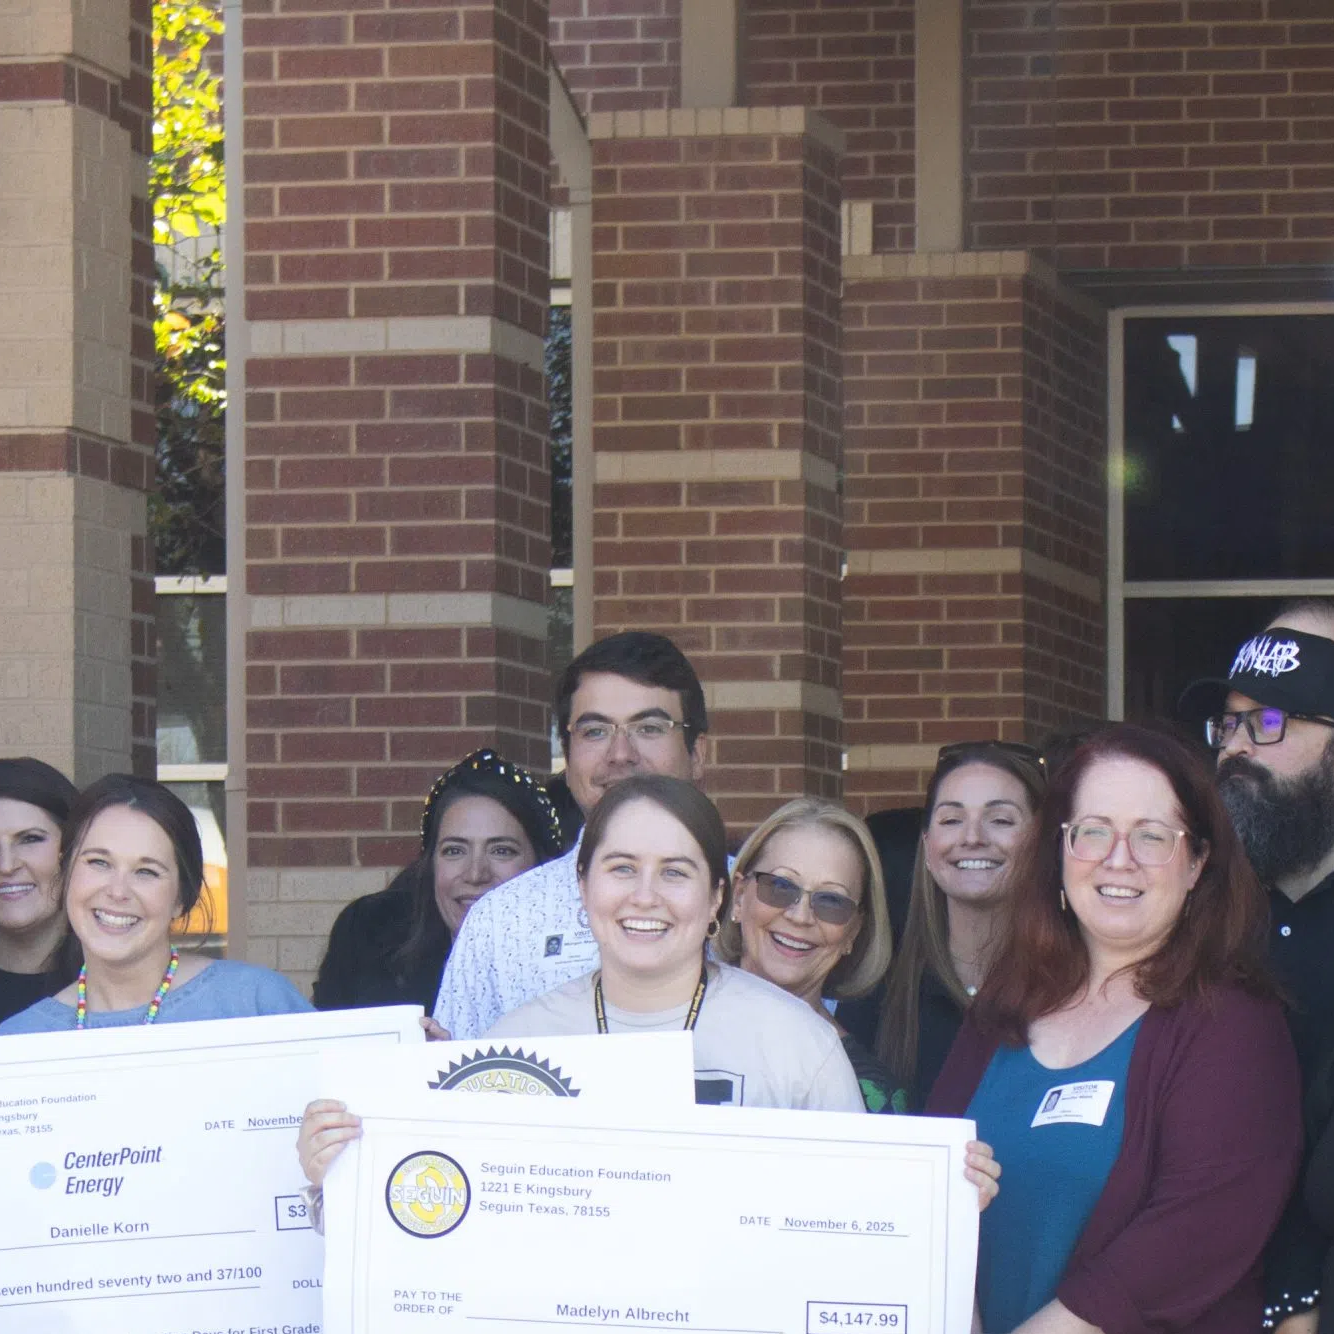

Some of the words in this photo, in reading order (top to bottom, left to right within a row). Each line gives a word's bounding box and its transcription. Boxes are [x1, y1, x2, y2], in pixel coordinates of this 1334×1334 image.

[41, 1093, 96, 1105] Foundation
[25, 1125, 53, 1134] 78155
[205, 1120, 235, 1130] DATE
[64, 1145, 162, 1169] CenterPoint
[481, 1163, 525, 1175] Seguin
[530, 1165, 593, 1178] Education
[598, 1168, 671, 1182] Foundation
[66, 1176, 124, 1197] Energy
[481, 1182, 508, 1192] 1221
[514, 1184, 522, 1193] E
[527, 1184, 591, 1199] Kingsbury
[390, 1185, 466, 1206] SEGUIN
[479, 1201, 523, 1214] Seguin
[529, 1203, 568, 1216] Texas,
[573, 1206, 610, 1217] 78155
[51, 1223, 109, 1239] Danielle
[114, 1221, 149, 1234] Korn
[740, 1216, 771, 1226] DATE
[785, 1218, 847, 1230] November
[852, 1221, 862, 1232] 6,
[866, 1222, 895, 1232] 2025
[37, 1278, 93, 1293] hundred
[98, 1276, 152, 1288] seventy
[157, 1273, 181, 1284] two
[186, 1270, 212, 1282] and
[217, 1267, 262, 1280] 37/100
[394, 1290, 417, 1299] PAY
[421, 1291, 436, 1300] TO
[441, 1292, 462, 1301] THE
[394, 1304, 434, 1314] ORDER
[439, 1306, 453, 1315] OF
[557, 1304, 619, 1321] Madelyn
[625, 1308, 689, 1322] Albrecht
[819, 1312, 898, 1327] $4,147.99
[282, 1324, 320, 1334] Grade
